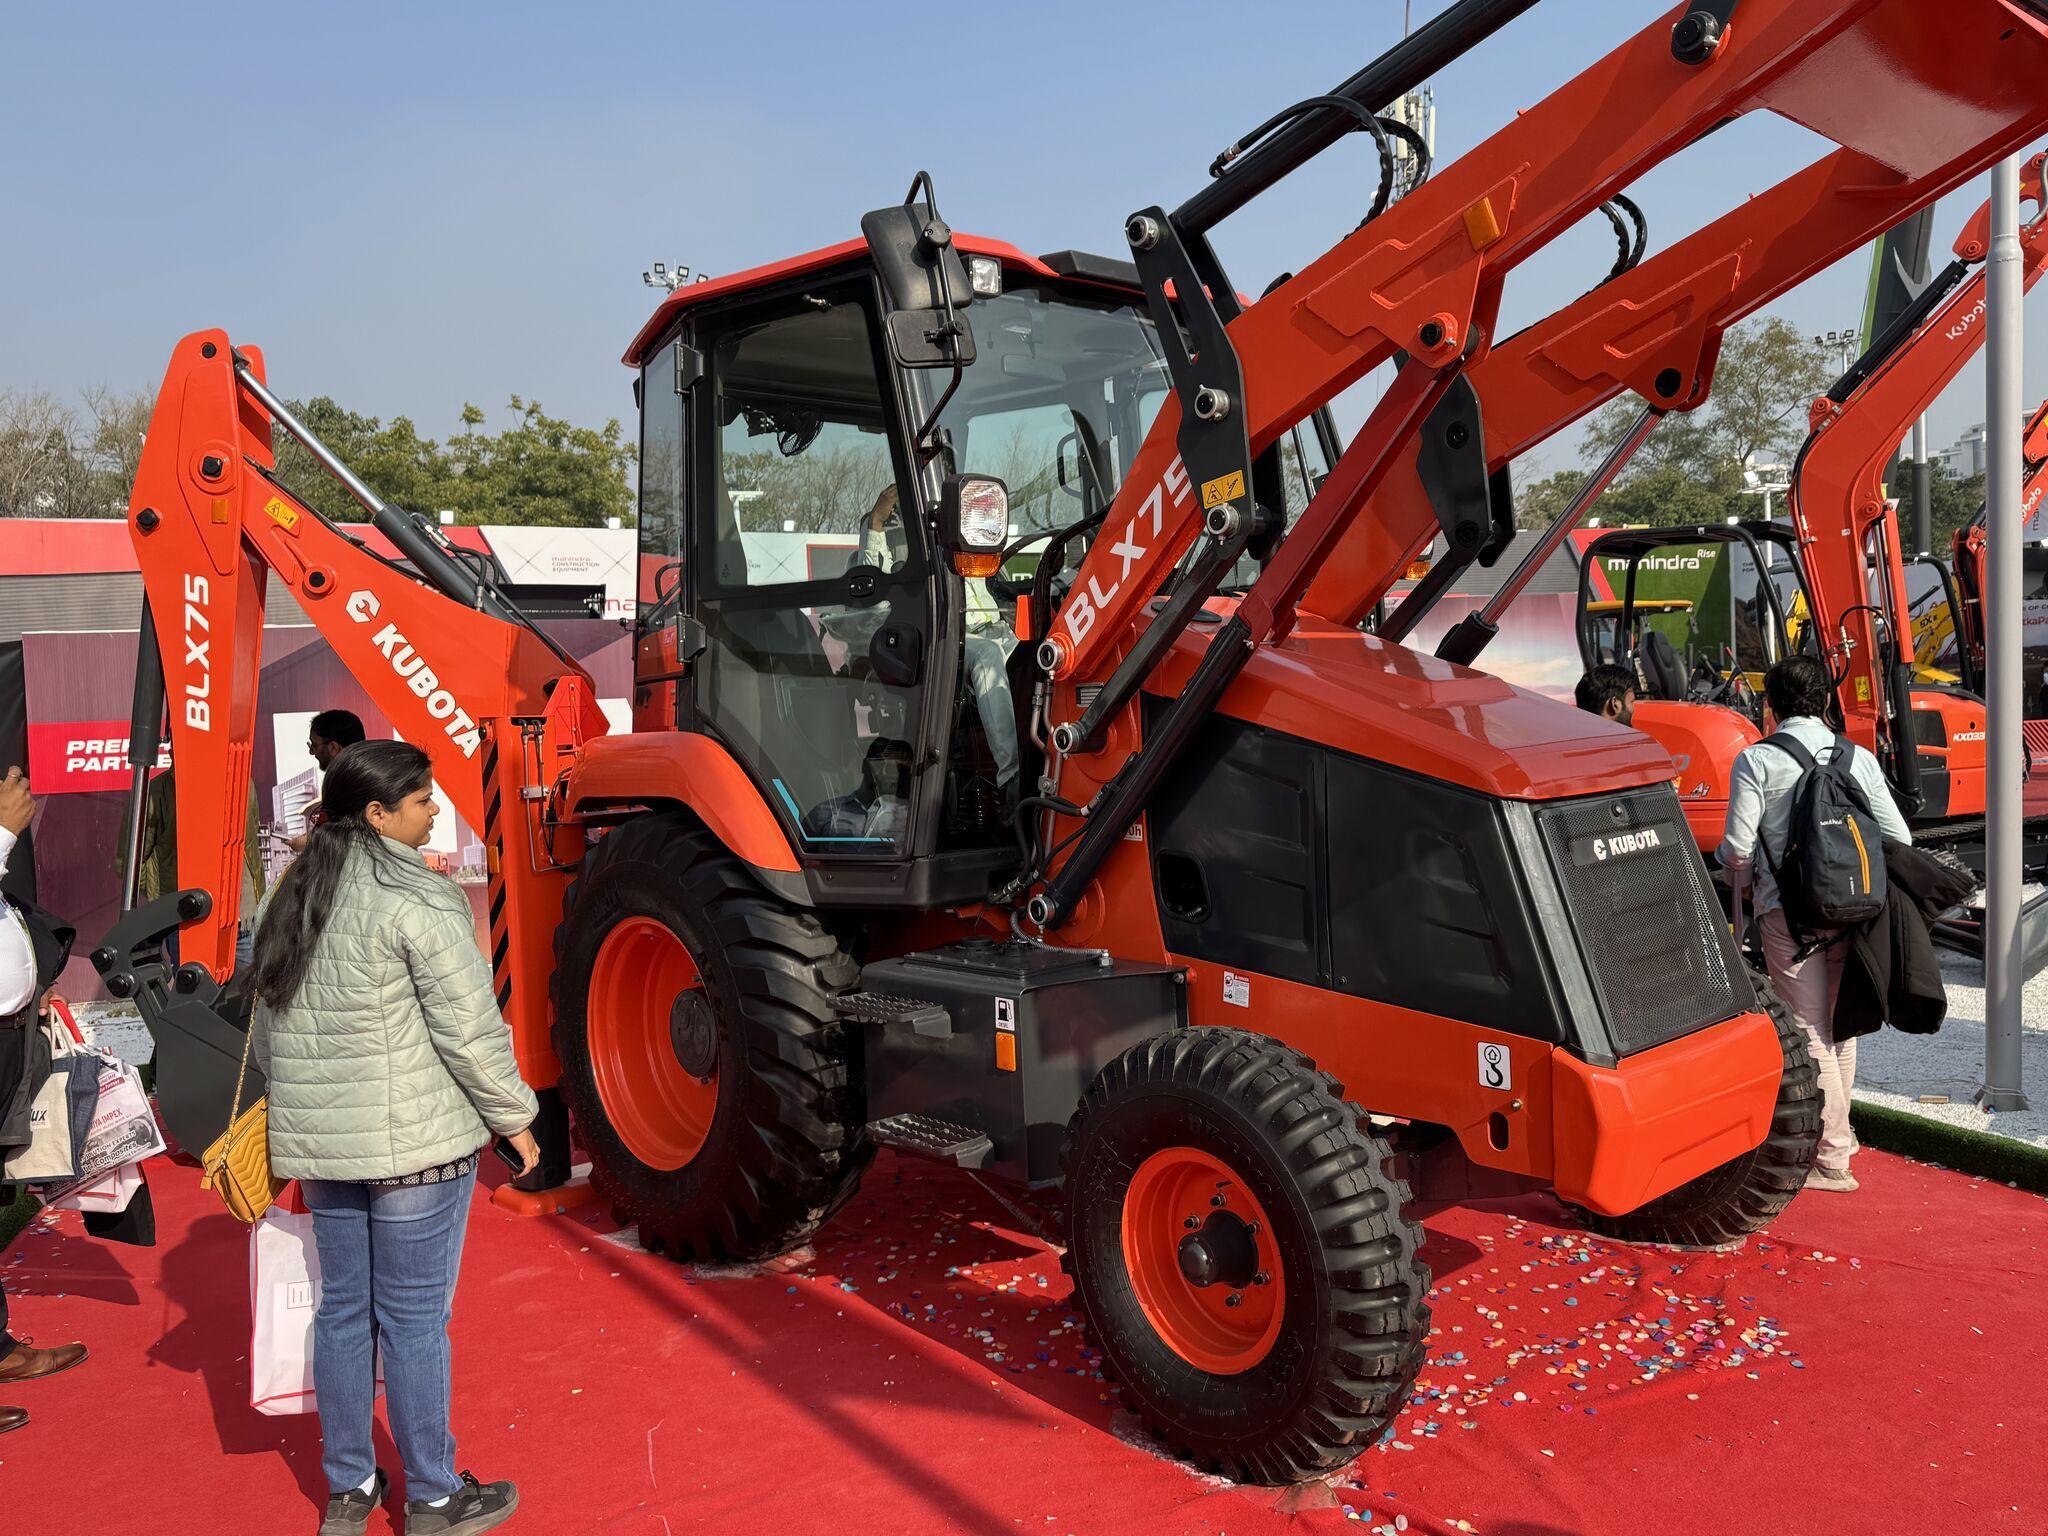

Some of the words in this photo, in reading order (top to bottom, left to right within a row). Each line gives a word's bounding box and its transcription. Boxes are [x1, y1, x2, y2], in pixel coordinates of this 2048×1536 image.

[1945, 296, 1987, 340] Kubot
[1064, 453, 1193, 648] BLX75
[1697, 549, 1716, 558] Rise
[184, 573, 211, 733] BLX75
[370, 622, 482, 760] KUBOTA
[1608, 829, 1661, 856] KUBOTA
